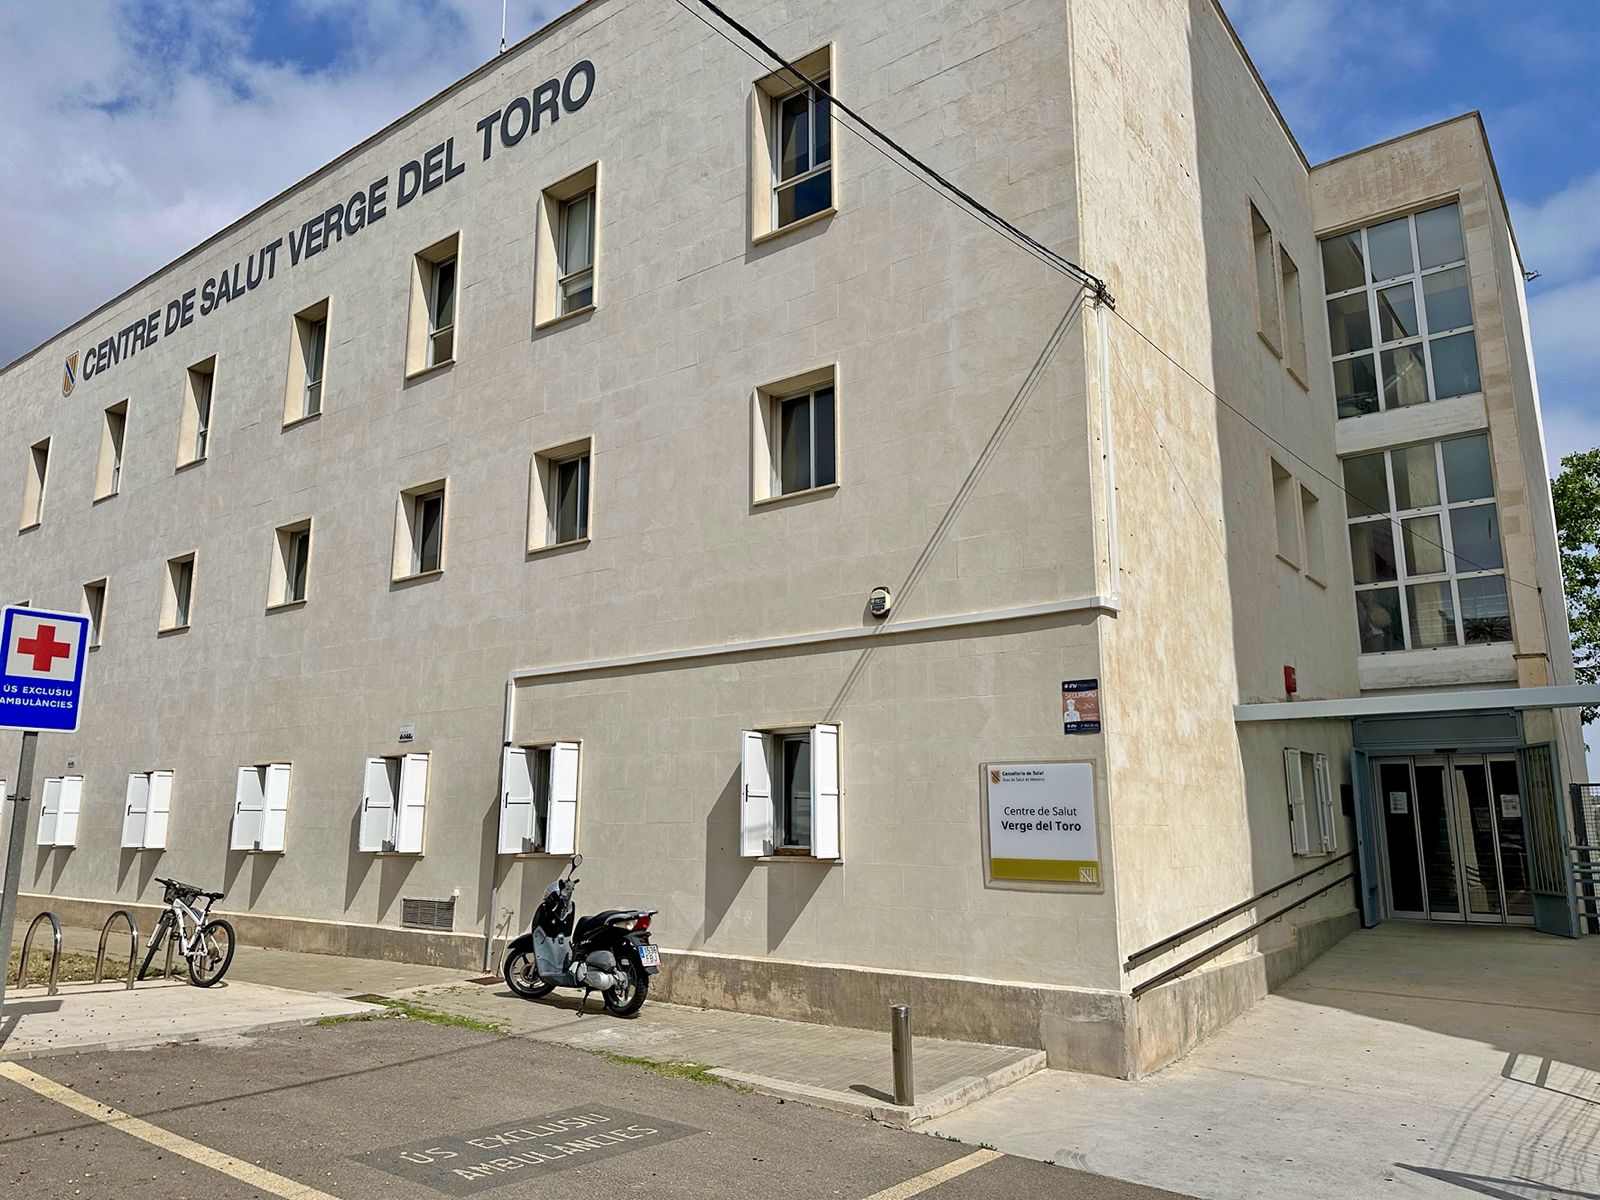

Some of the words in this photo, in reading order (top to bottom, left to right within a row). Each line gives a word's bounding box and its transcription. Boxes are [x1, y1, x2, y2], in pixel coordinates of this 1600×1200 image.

[82, 309, 161, 381] CENTRE
[164, 288, 196, 337] DE
[200, 238, 283, 316] SALUT
[288, 176, 389, 266] VERGE
[397, 137, 465, 209] DEL
[476, 59, 596, 161] TORO
[3, 683, 18, 693] ÚS
[22, 686, 73, 696] EXCLUSIU
[1064, 690, 1097, 699] SEGURIDAD
[0, 697, 73, 708] AMBULÀNCIES
[1004, 806, 1035, 816] Centre
[1037, 806, 1050, 816] de
[1052, 806, 1077, 816] Salut
[1001, 821, 1033, 833] Verge
[1036, 821, 1052, 831] del
[1055, 821, 1082, 831] Toro
[399, 1147, 458, 1164] ÚS
[465, 1113, 611, 1150] EXCLUSIU
[452, 1124, 658, 1181] AMBULÀNCIES
